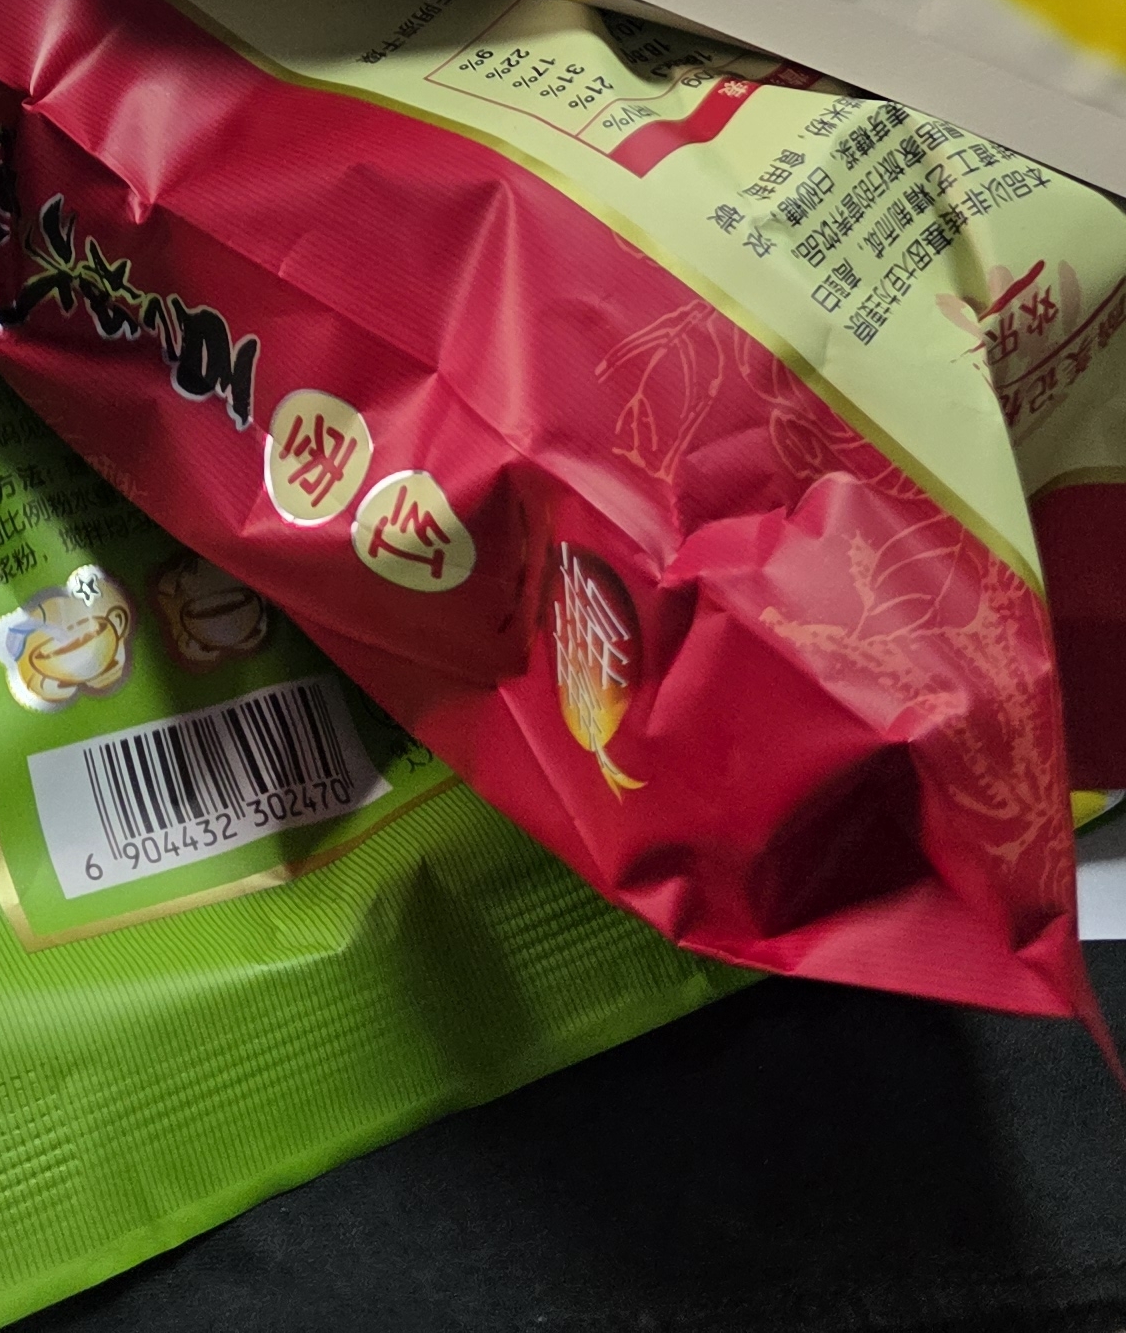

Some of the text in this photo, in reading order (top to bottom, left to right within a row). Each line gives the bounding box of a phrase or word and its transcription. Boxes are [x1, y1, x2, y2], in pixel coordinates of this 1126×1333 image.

[458, 48, 495, 71] 9%
[485, 48, 531, 81] 22%
[512, 57, 556, 88] 17%
[539, 63, 585, 99] 31%
[568, 75, 614, 110] 21%
[85, 778, 353, 880] 6 904432 302470
